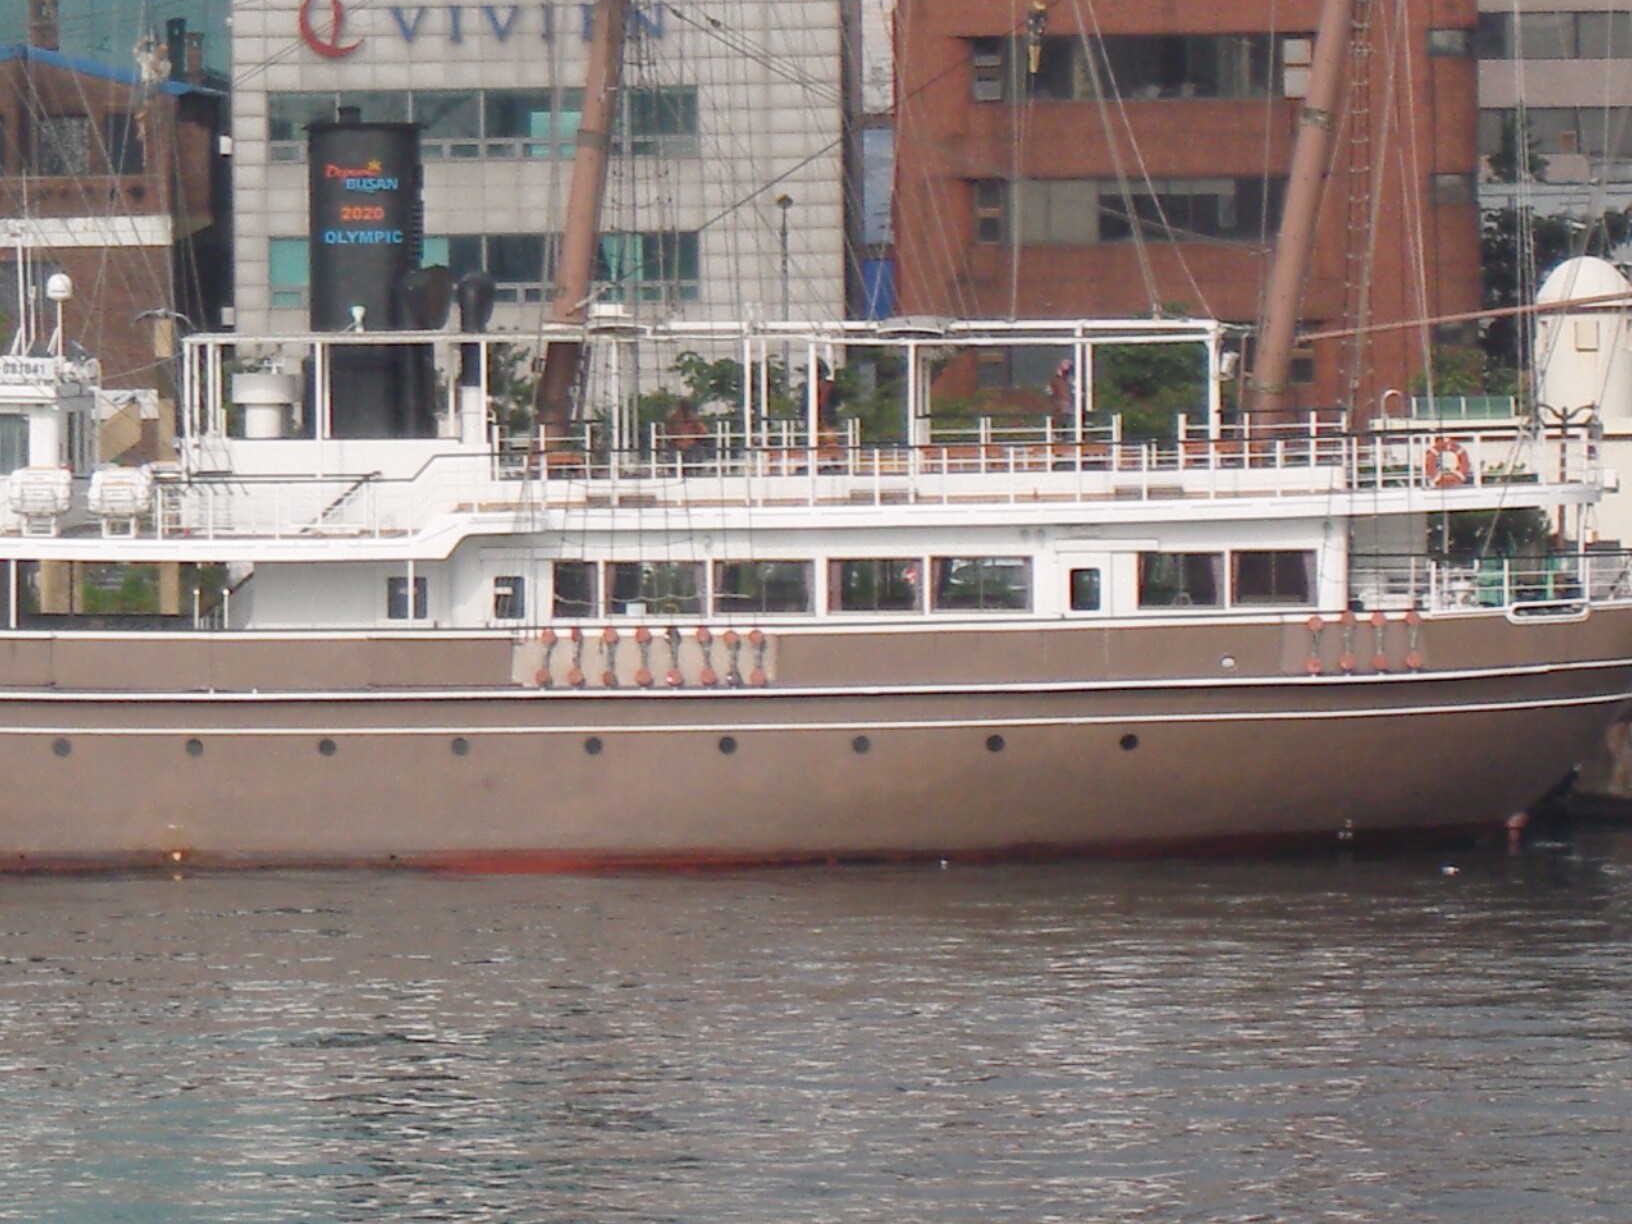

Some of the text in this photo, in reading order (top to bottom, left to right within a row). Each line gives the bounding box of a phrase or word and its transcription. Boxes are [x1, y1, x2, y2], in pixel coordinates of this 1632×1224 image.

[345, 177, 399, 191] BUSAN
[340, 206, 385, 221] 2020
[324, 230, 404, 245] OLYMPIC
